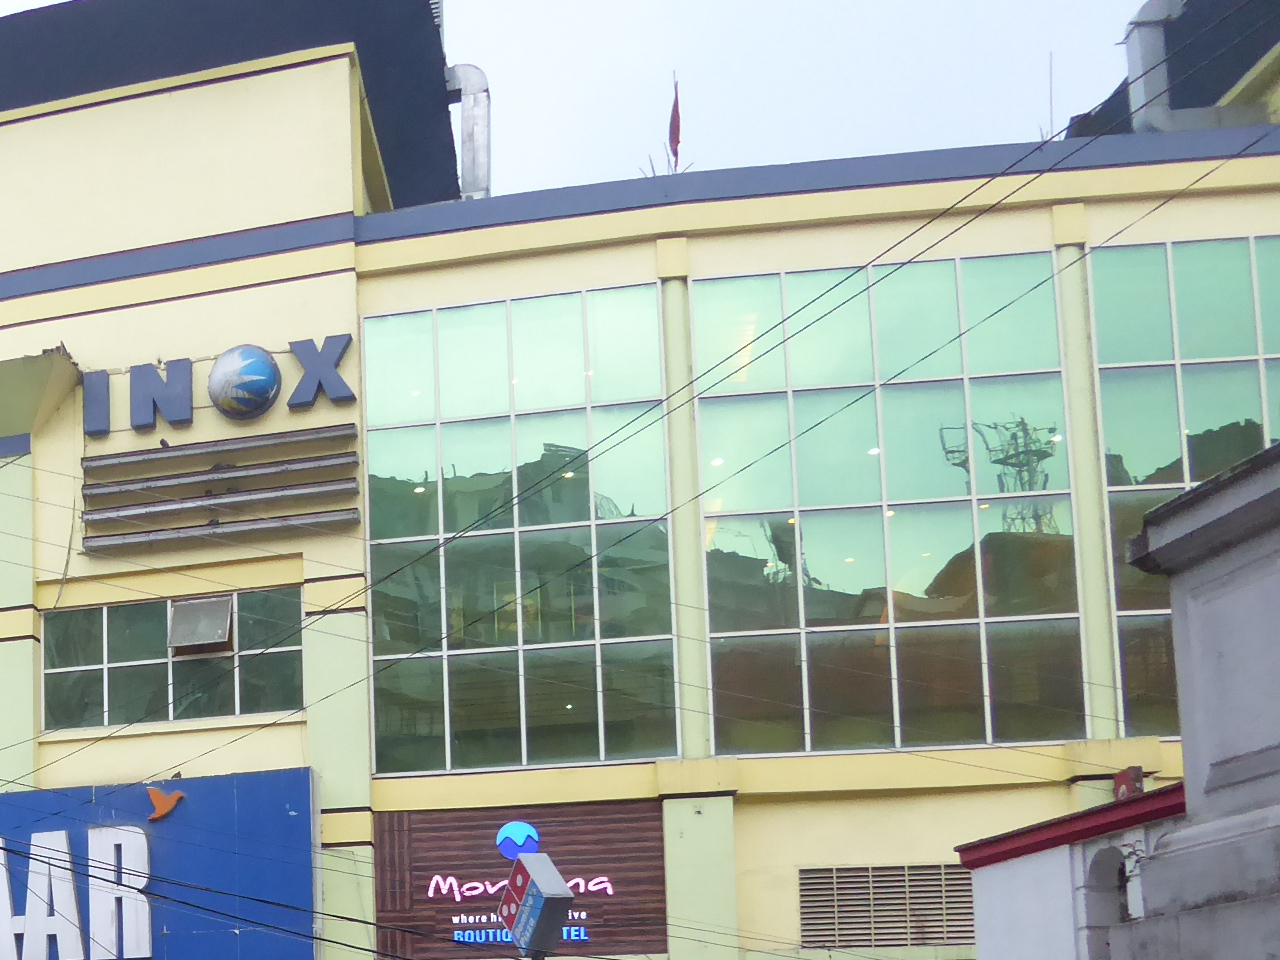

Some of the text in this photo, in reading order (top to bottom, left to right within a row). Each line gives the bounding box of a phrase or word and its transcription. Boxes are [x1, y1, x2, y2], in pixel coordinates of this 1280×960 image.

[83, 333, 357, 437] INOX
[452, 913, 487, 924] where
[454, 926, 589, 942] BOUTIQ TEL
